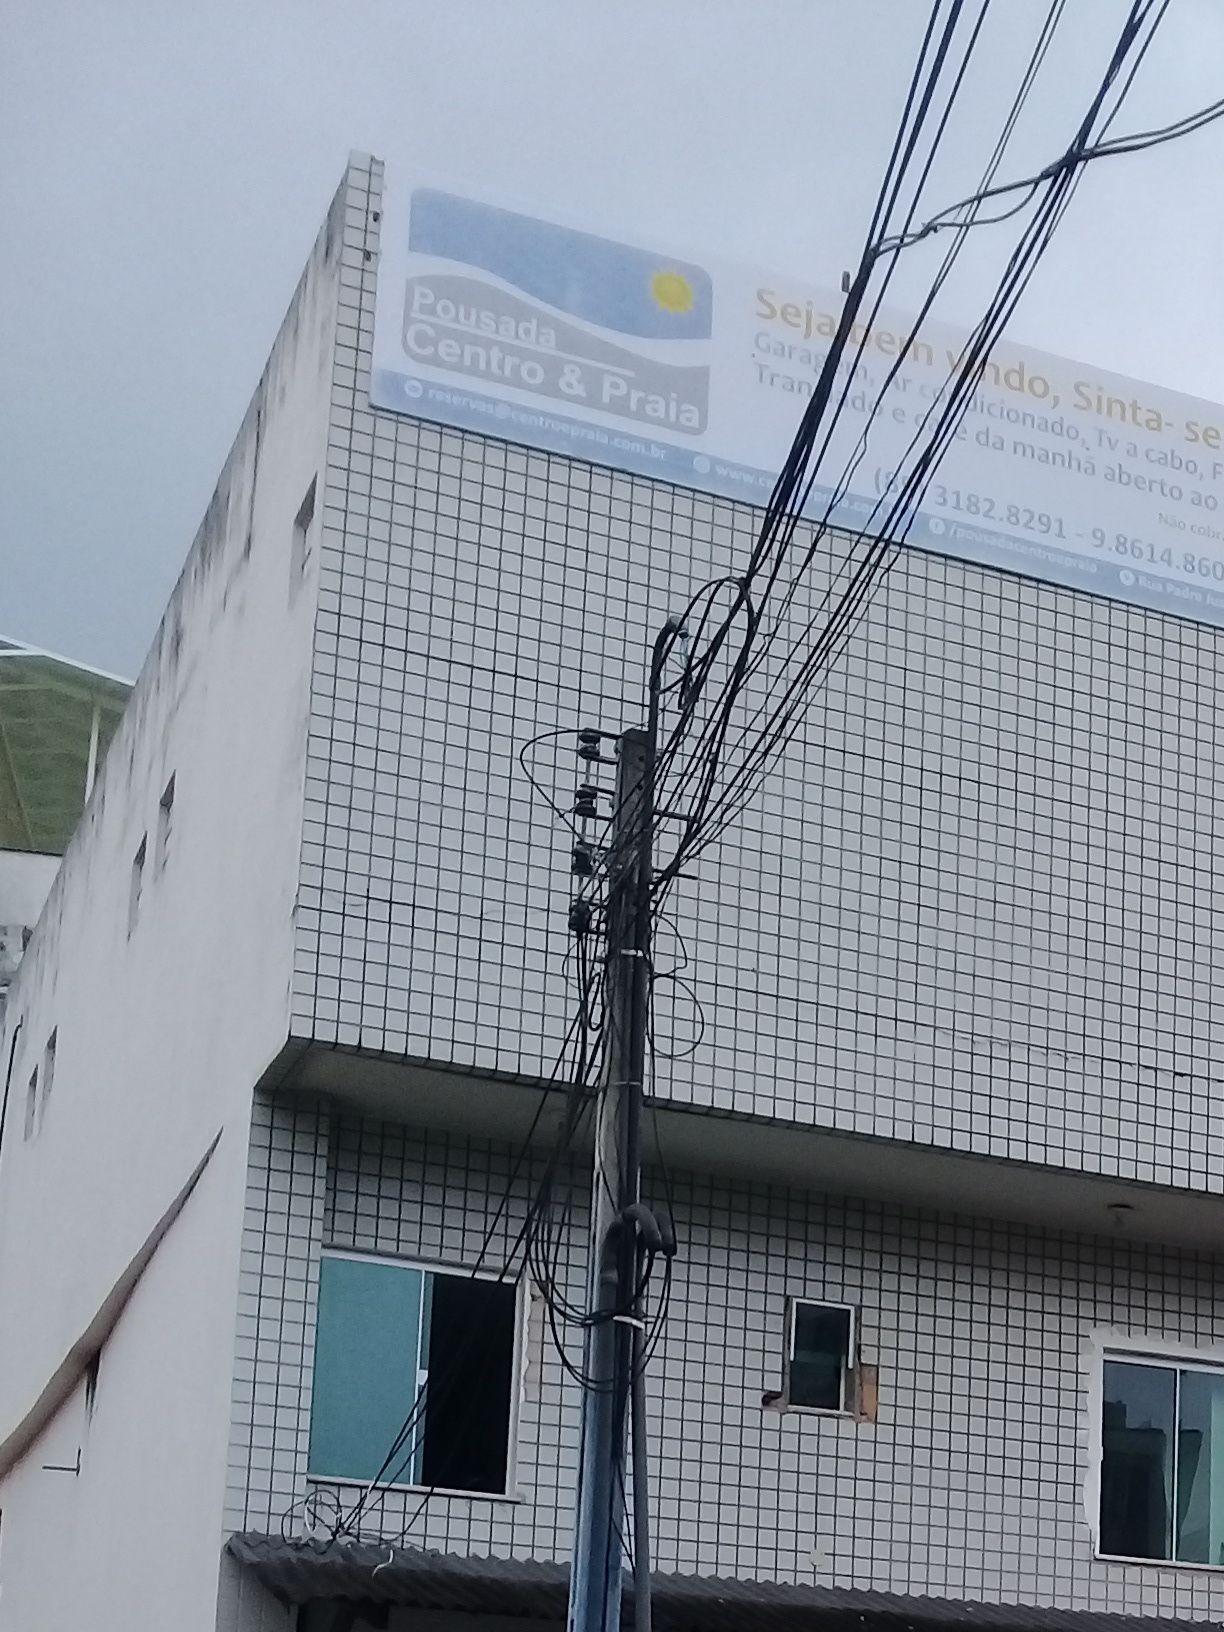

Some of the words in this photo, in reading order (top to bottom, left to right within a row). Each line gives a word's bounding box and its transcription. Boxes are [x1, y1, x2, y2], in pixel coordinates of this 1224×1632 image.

[411, 286, 557, 348] Pousada
[406, 324, 545, 385] Centro
[558, 363, 587, 398] &
[602, 373, 700, 428] Praia
[755, 287, 836, 340] Seja
[1184, 418, 1221, 450] se
[892, 407, 906, 423] e
[975, 426, 1005, 451] da
[1013, 440, 1096, 476] manhã
[1104, 462, 1183, 501] aberto
[1191, 491, 1218, 511] ao
[1094, 427, 1119, 450] Tv
[1126, 440, 1138, 458] a
[1145, 450, 1204, 481] cabo,
[934, 484, 1067, 539] 3182.8291
[1158, 512, 1186, 530] Não
